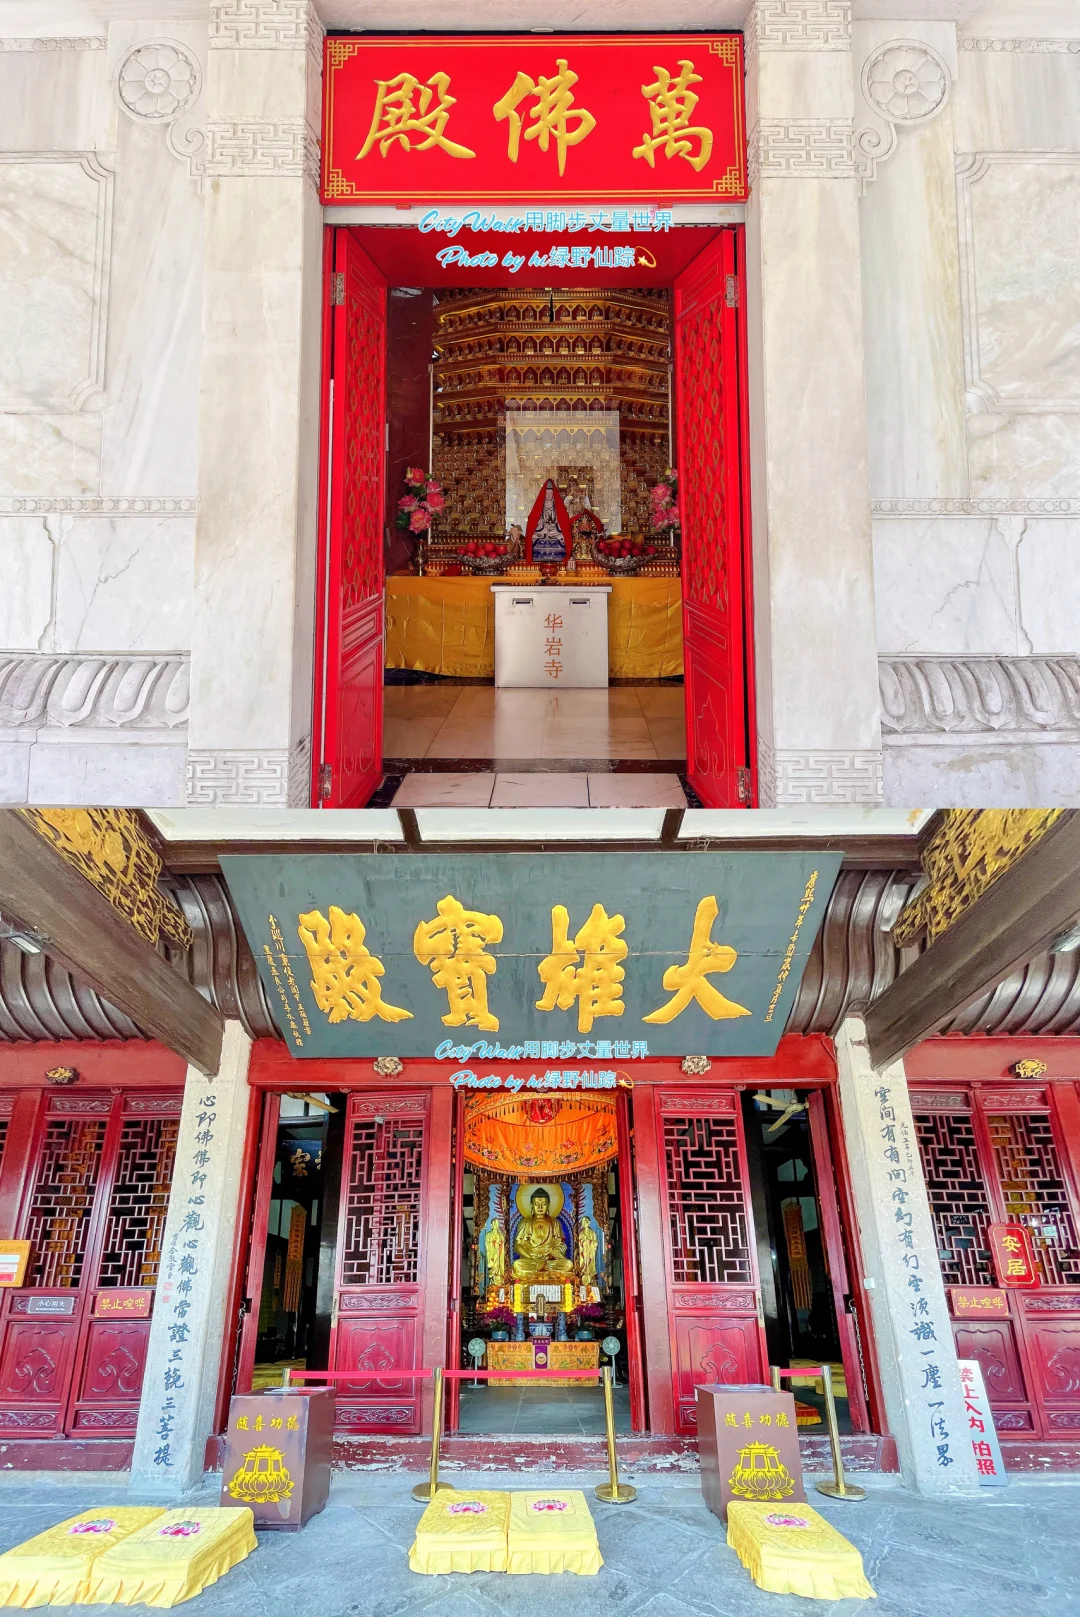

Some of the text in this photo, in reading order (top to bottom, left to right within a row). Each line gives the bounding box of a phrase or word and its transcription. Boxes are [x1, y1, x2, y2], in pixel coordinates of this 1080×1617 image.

[354, 58, 714, 177] 萬佛殿
[544, 613, 563, 680] 华岩寺
[1001, 1235, 1026, 1276] 安居
[100, 1298, 146, 1310] 禁止喧哗
[958, 1296, 1004, 1309] 禁止喧哗
